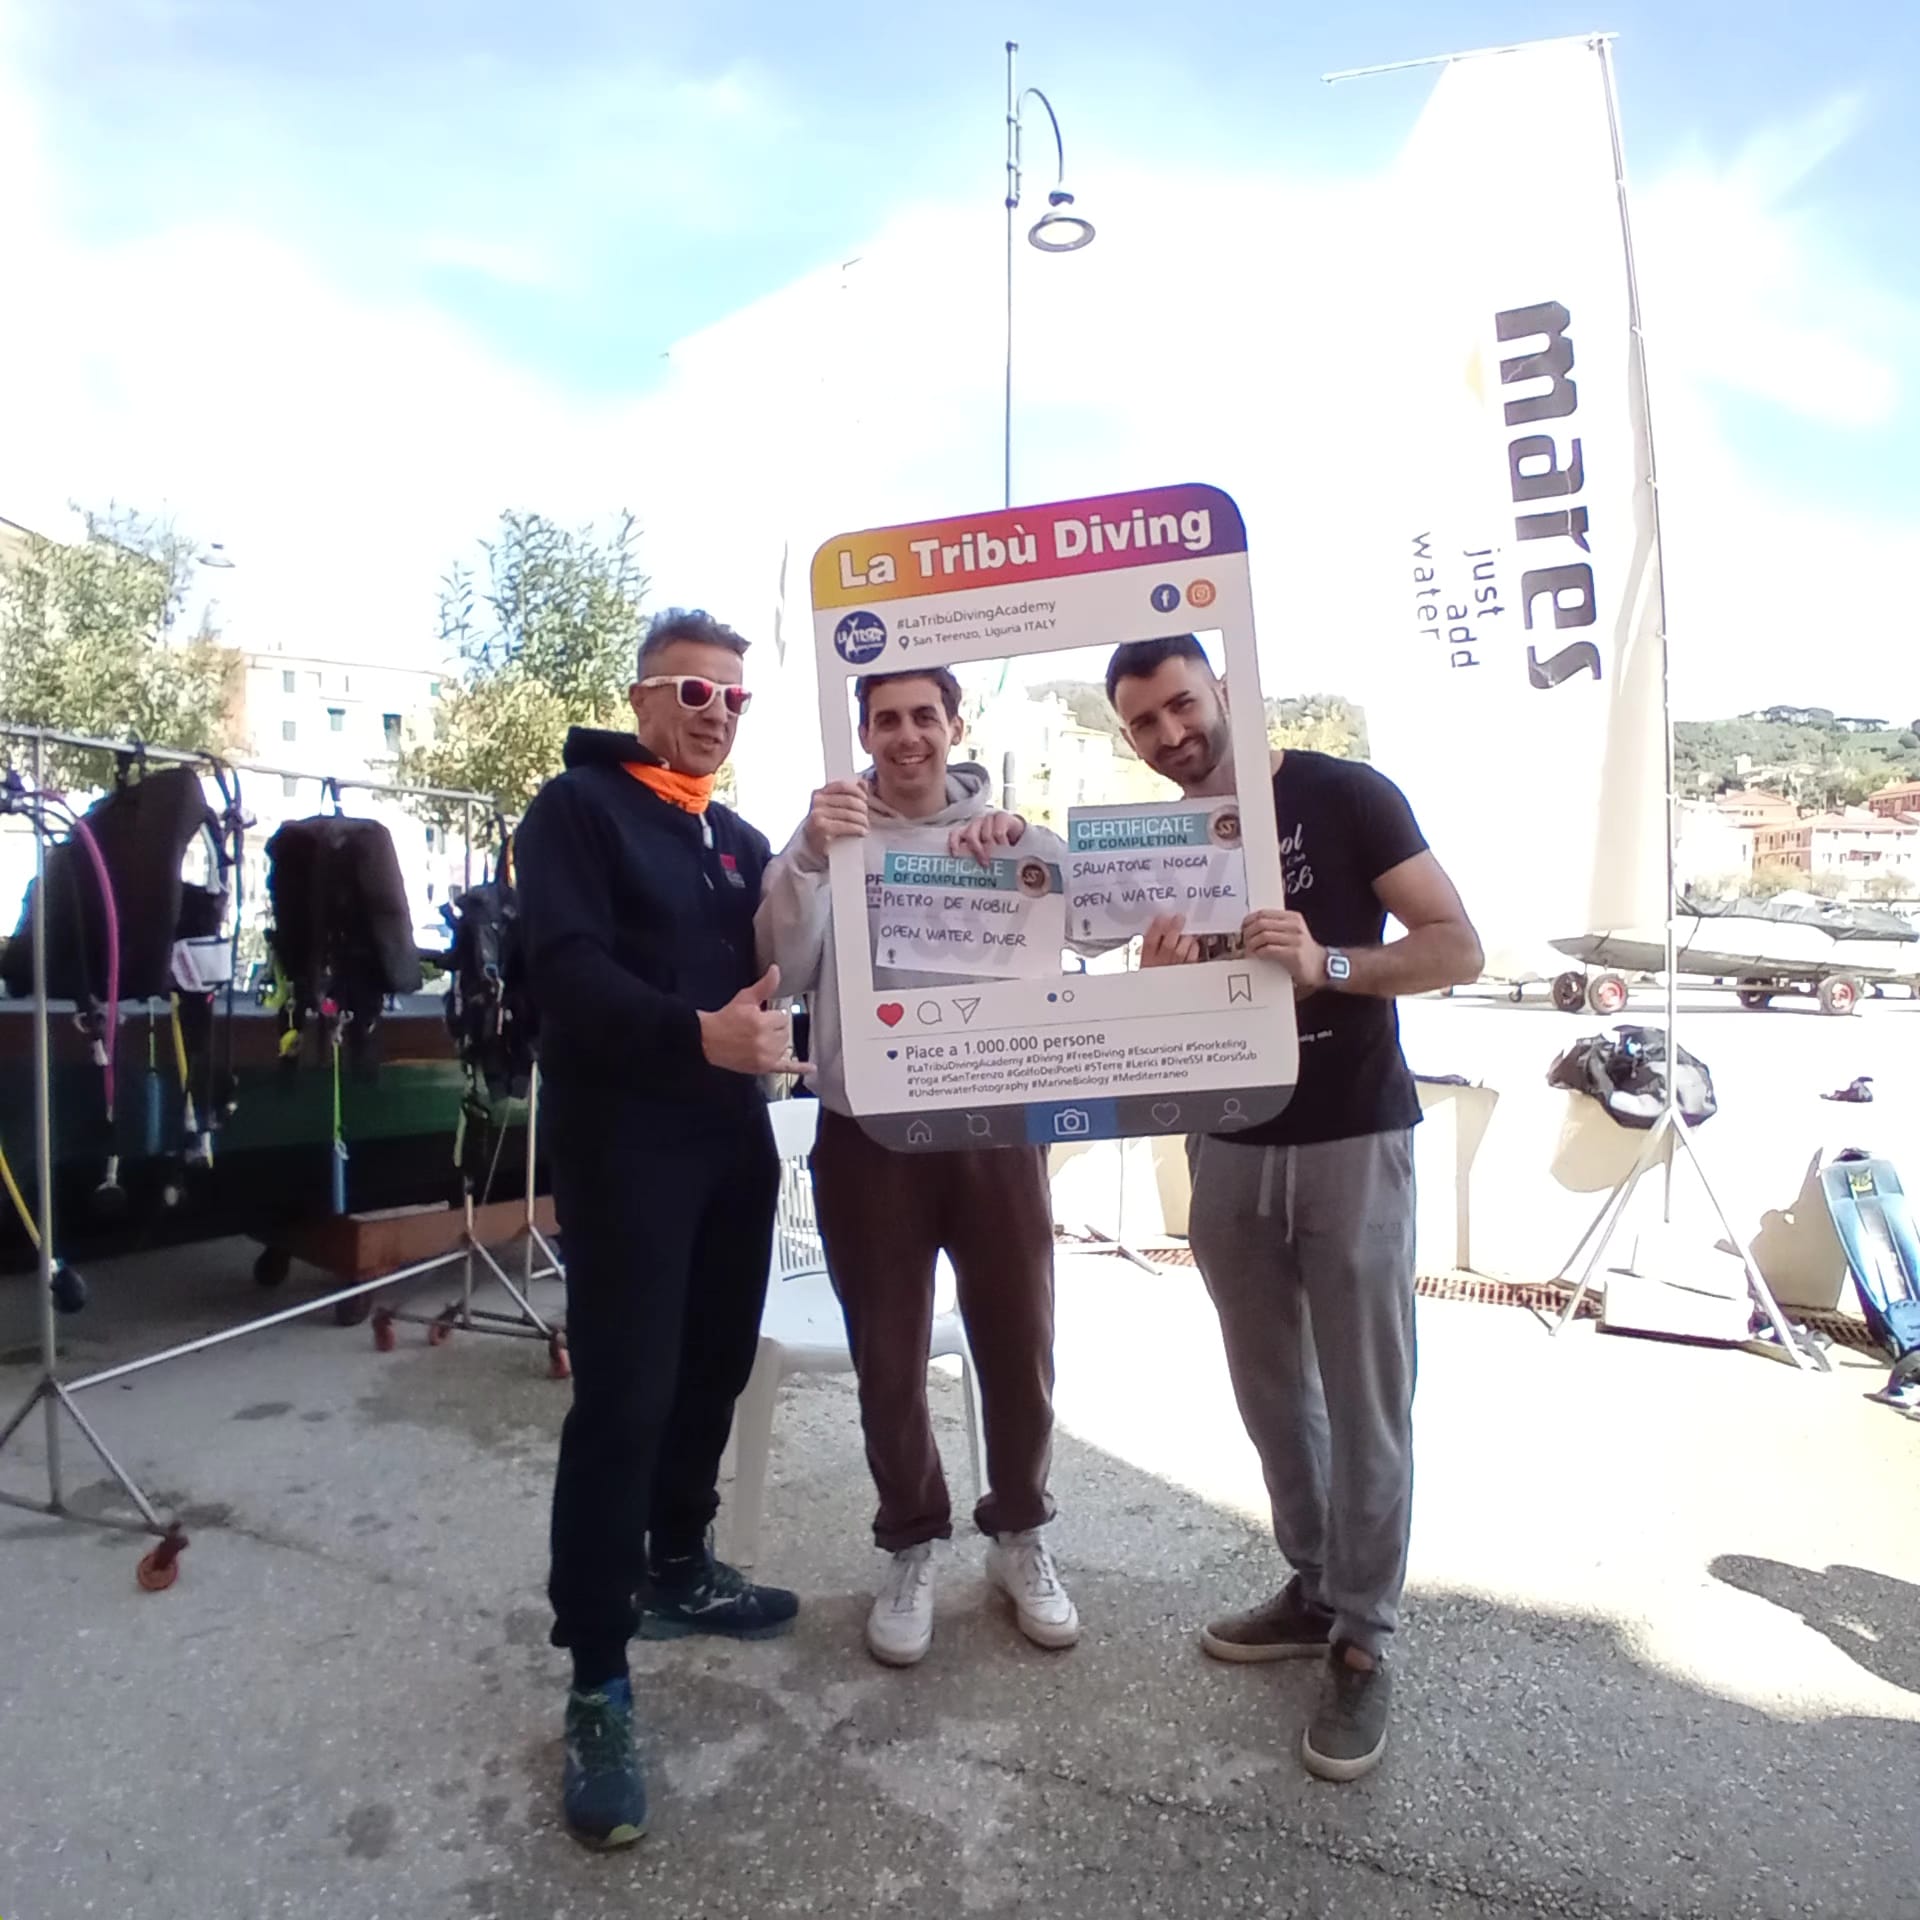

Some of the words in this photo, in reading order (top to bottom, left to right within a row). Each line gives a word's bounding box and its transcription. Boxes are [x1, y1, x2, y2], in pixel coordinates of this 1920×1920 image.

[1495, 301, 1601, 690] mares
[838, 550, 897, 590] La
[910, 524, 1038, 577] Tribù
[1052, 507, 1213, 559] Diving
[1411, 531, 1442, 641] water
[1463, 547, 1505, 619] just
[913, 636, 934, 647] San
[984, 625, 1021, 639] Liguria
[1024, 618, 1057, 632] ITALY
[1446, 603, 1480, 669] add
[1077, 815, 1195, 839] CERTIFICATE
[1078, 838, 1096, 851] OF
[1098, 833, 1188, 850] COMPLETION
[1163, 854, 1208, 869] NOCCA
[893, 872, 911, 884] OF
[912, 873, 998, 889] COMPLETION
[882, 889, 934, 909] PIETRO
[943, 896, 965, 909] DE
[970, 897, 1020, 914] NOBILI
[1072, 891, 1113, 908] OPEN
[1122, 885, 1177, 903] WATER
[1186, 884, 1237, 899] DIVER
[881, 924, 921, 940] OPEN
[925, 927, 975, 943] WATER
[983, 931, 1028, 948] DIVER
[905, 1045, 945, 1060] Piace
[949, 1045, 958, 1056] a
[963, 1035, 1038, 1055] 1.000.000
[1042, 1033, 1105, 1052] persone
[1026, 1051, 1064, 1063] #Diving
[1185, 1038, 1247, 1052] #Snorkeling
[907, 1076, 939, 1088] #Yoga
[941, 1070, 1005, 1083] #SanTerenzo
[1006, 1063, 1083, 1079] #GolfoDeiPoeti
[1125, 1057, 1159, 1070] #Lerici
[1206, 1050, 1258, 1063] #CorsiSub
[1031, 1074, 1110, 1089] #MarineBiology
[1112, 1069, 1189, 1083] #Mediterraneo
